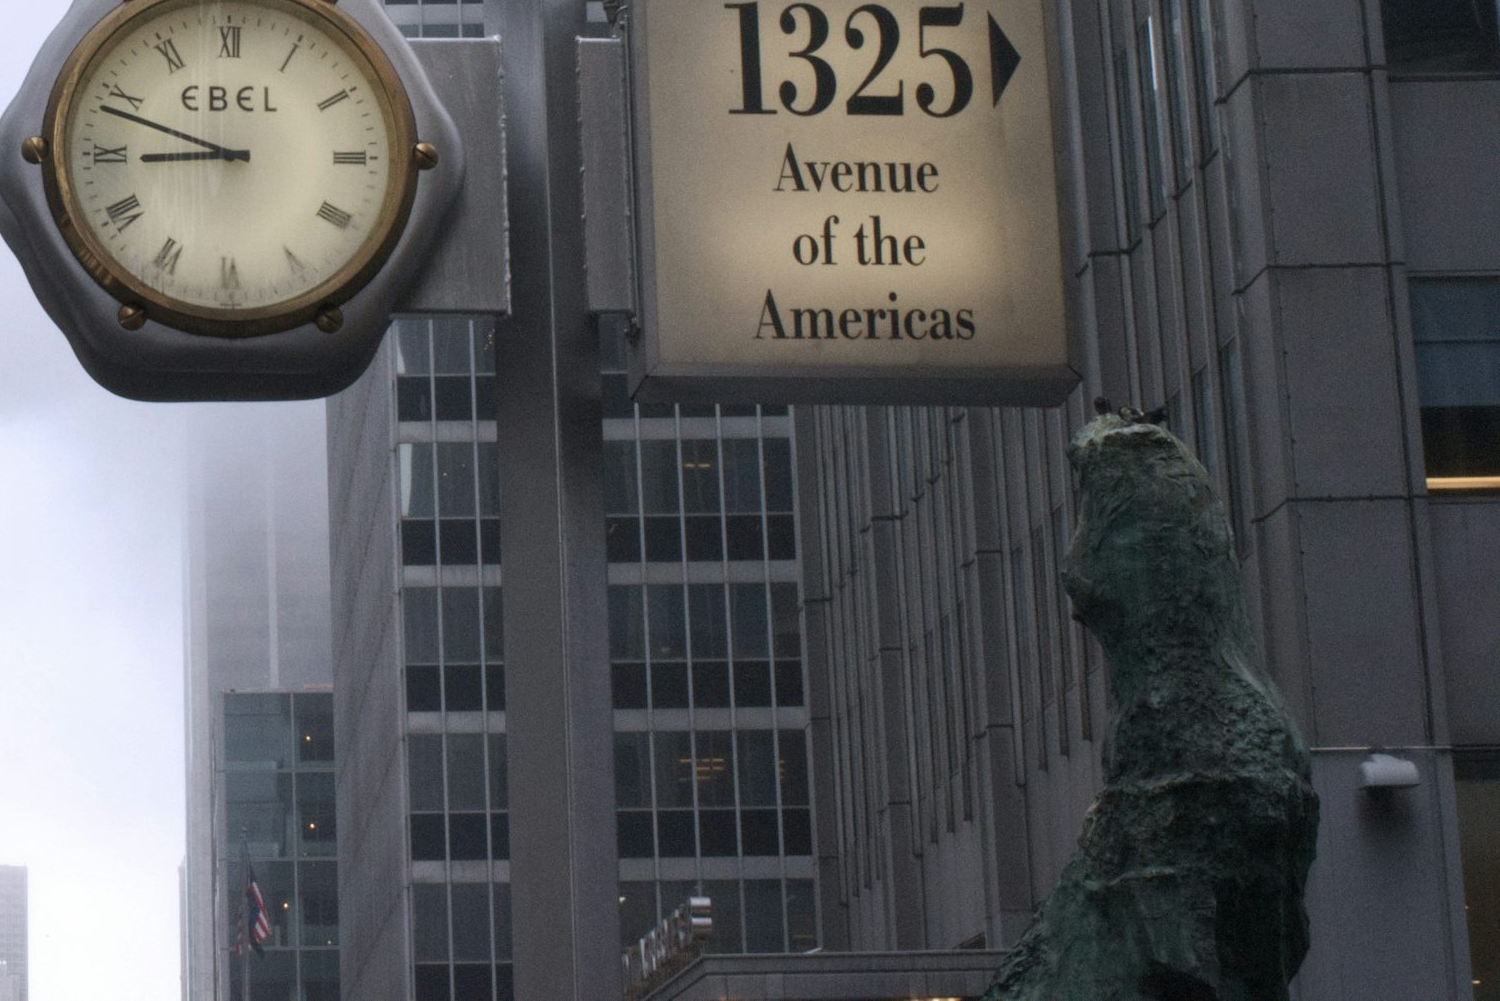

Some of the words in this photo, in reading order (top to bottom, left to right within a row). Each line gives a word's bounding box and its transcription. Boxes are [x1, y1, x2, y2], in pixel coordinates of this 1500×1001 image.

[153, 38, 187, 74] XI
[217, 26, 242, 59] XII
[723, 1, 974, 118] 1325
[108, 83, 144, 112] X
[181, 85, 278, 112] EBEL
[316, 88, 349, 112] II
[93, 144, 128, 165] IX
[332, 149, 367, 166] III
[773, 141, 939, 194] Avenue
[105, 192, 145, 234] VIII
[792, 215, 839, 266] of
[853, 215, 926, 266] the
[752, 288, 976, 341] Americas
